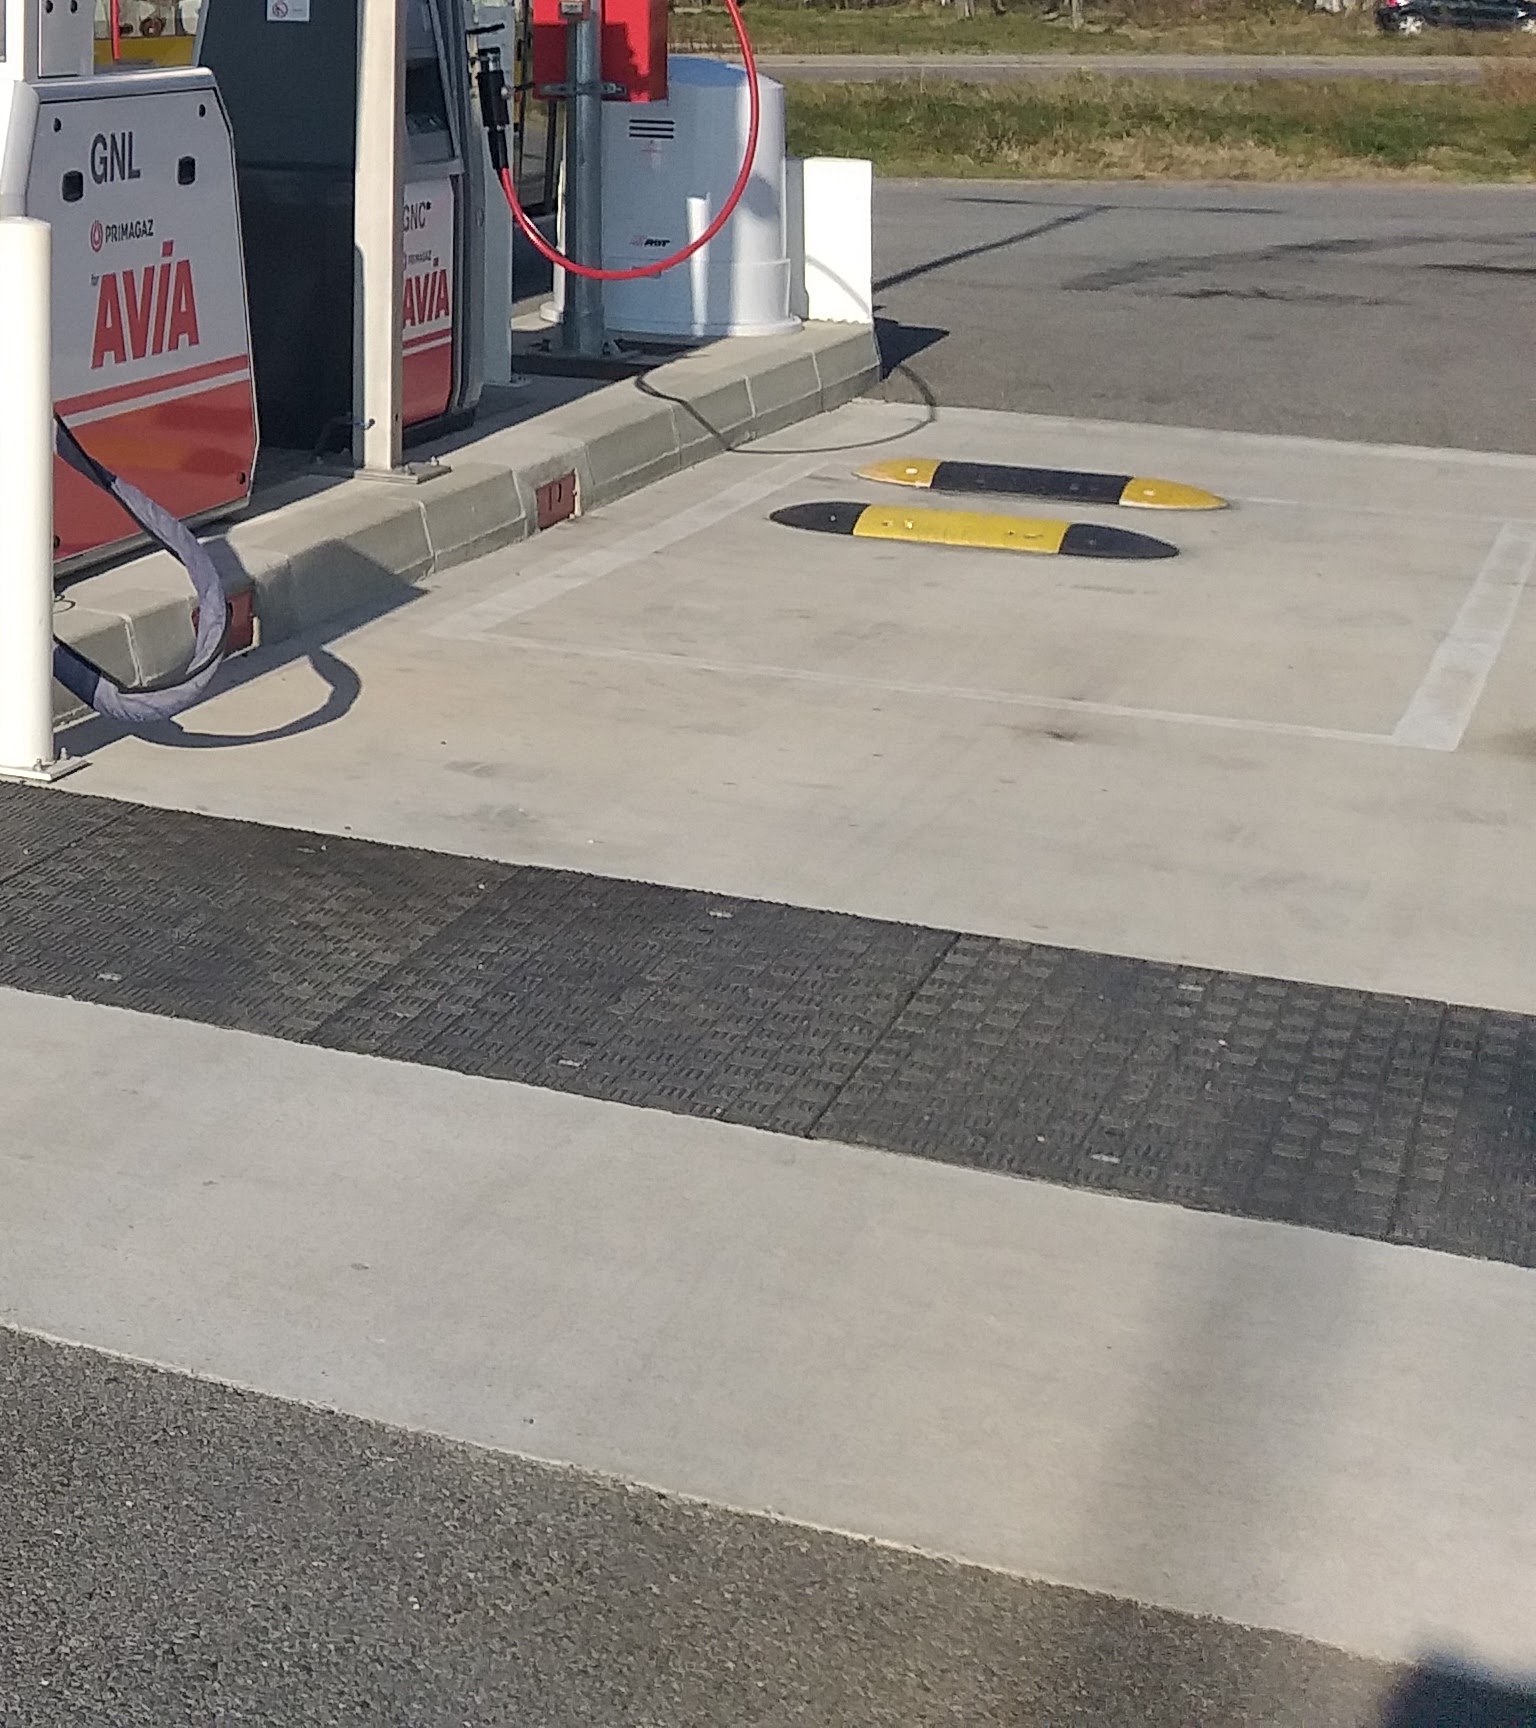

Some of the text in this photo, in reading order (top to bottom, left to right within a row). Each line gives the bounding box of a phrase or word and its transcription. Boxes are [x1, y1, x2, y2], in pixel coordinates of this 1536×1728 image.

[90, 131, 141, 185] GNL
[105, 219, 154, 243] PRIMAGAZ
[90, 239, 200, 370] AVIA
[403, 257, 450, 328] AVIA
